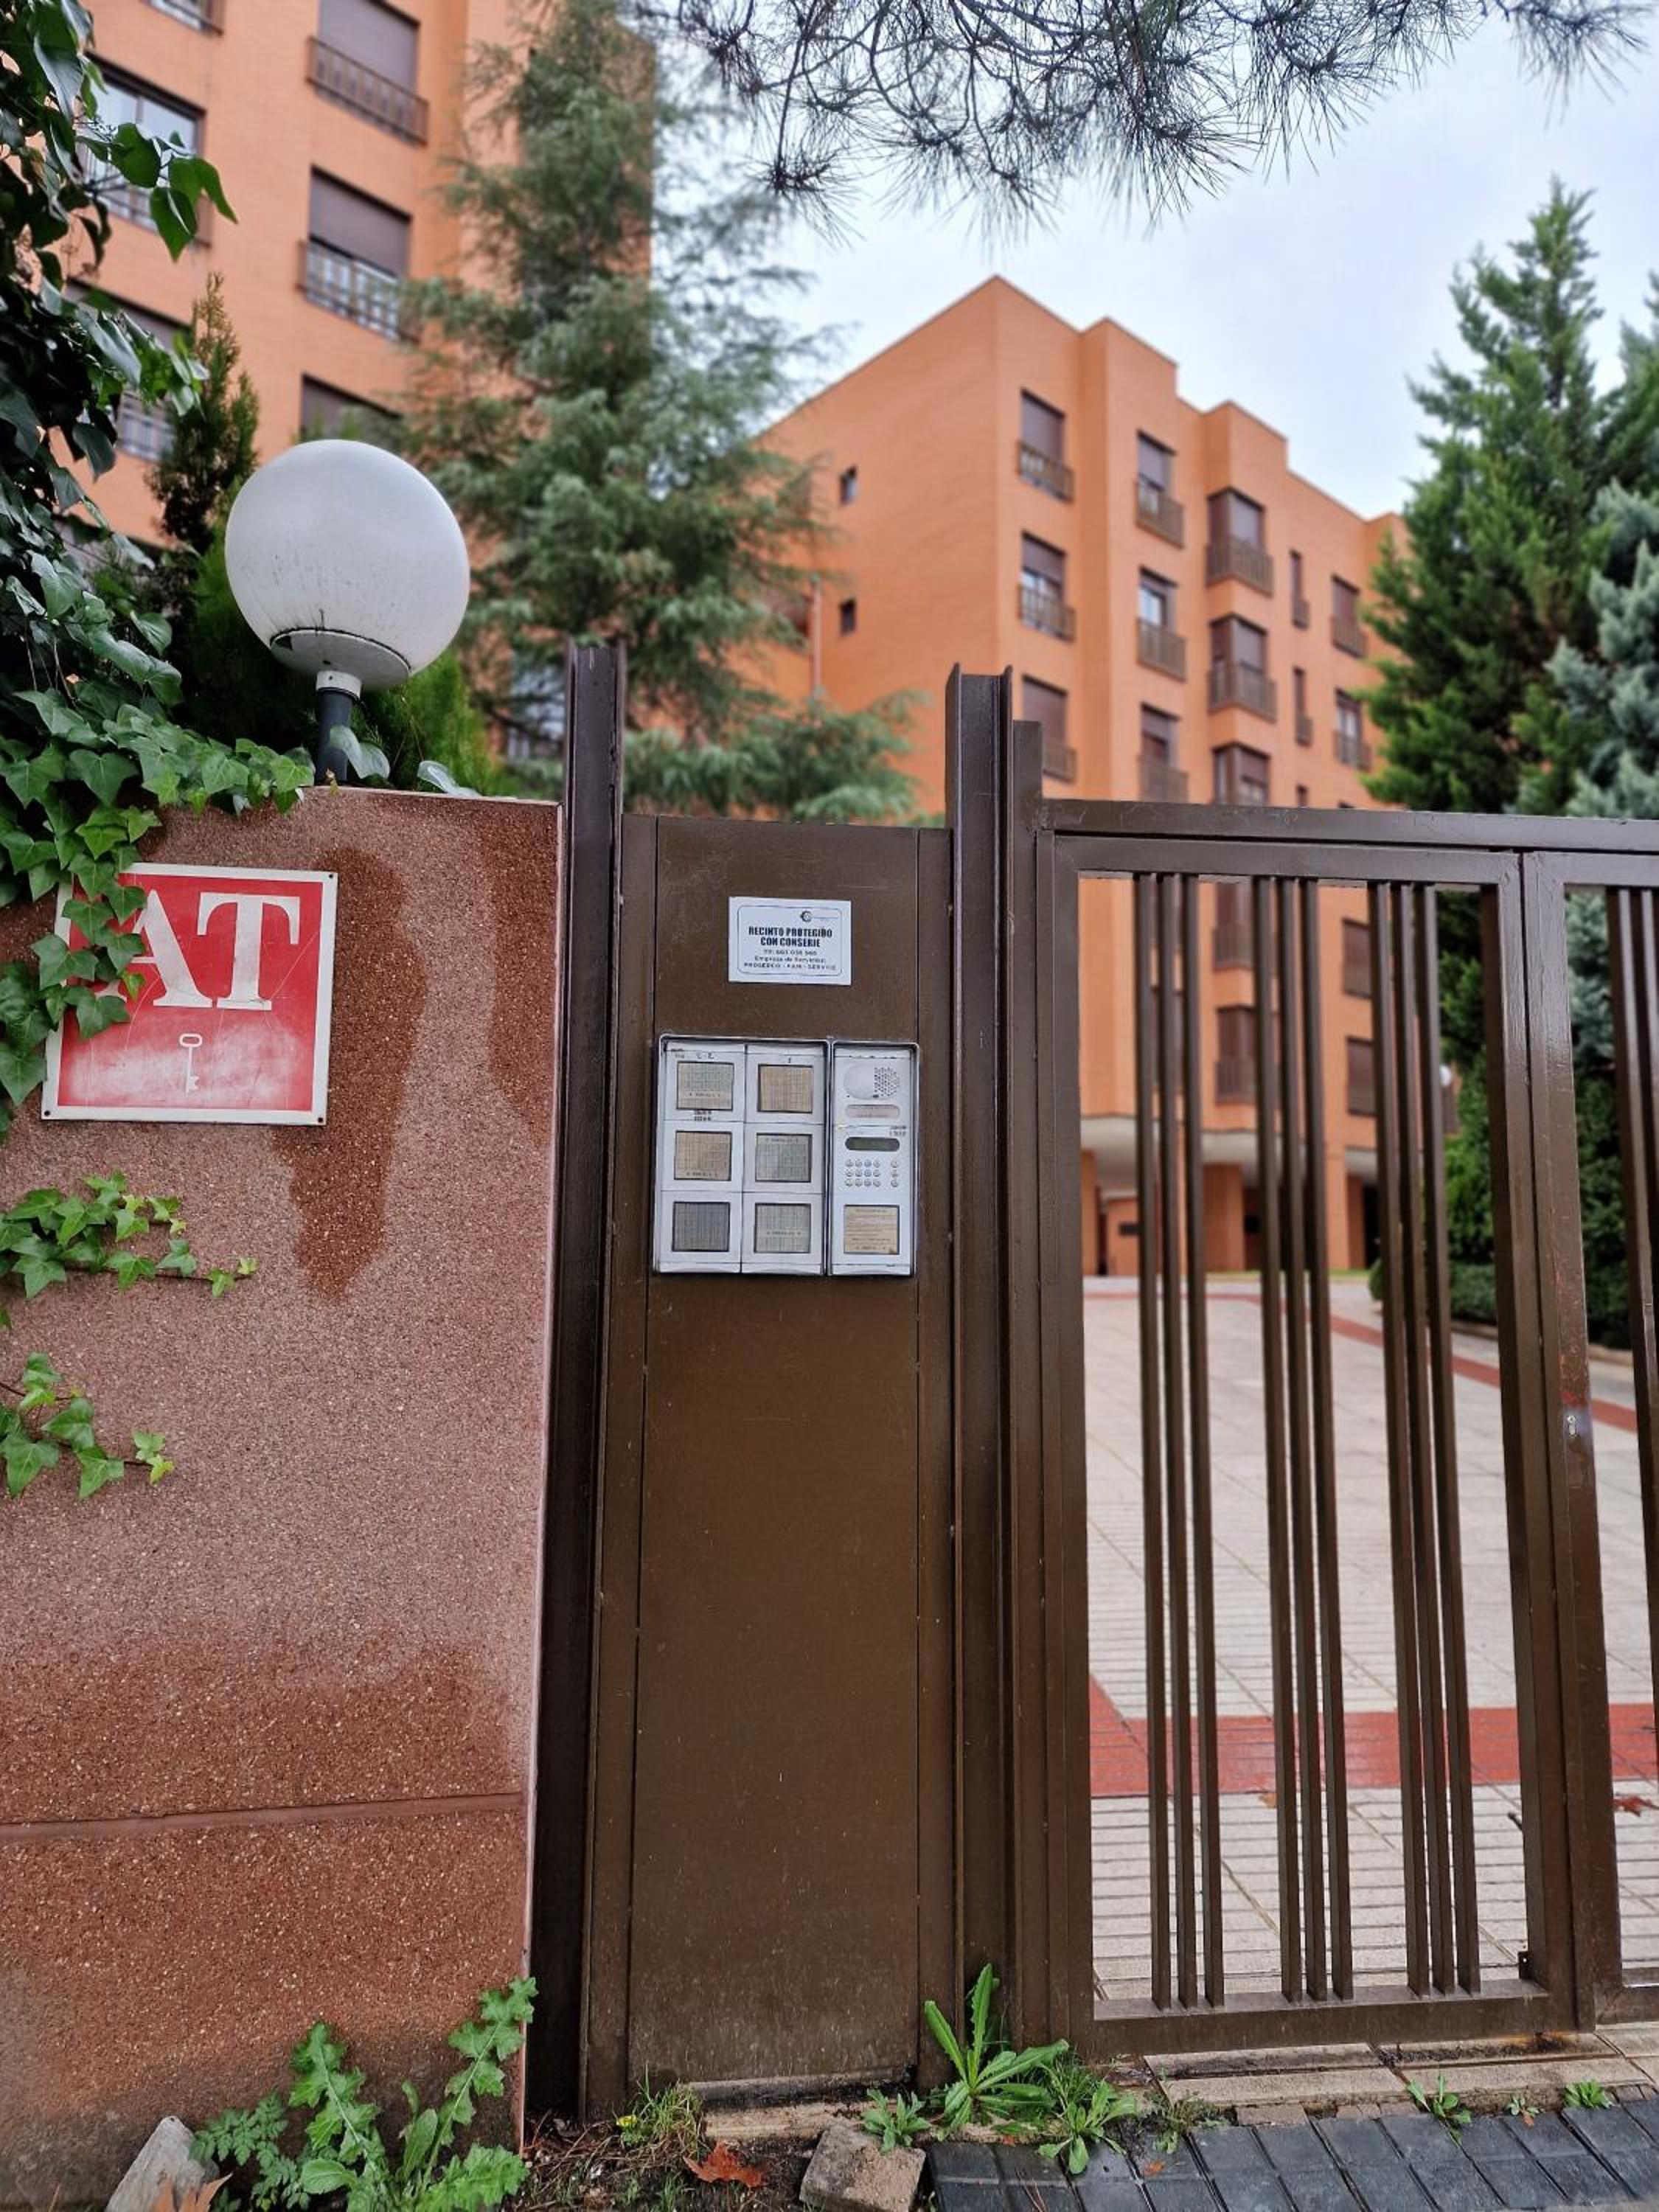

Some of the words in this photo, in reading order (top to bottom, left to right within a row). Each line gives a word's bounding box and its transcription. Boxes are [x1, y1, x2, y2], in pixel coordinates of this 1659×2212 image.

[748, 926, 785, 936] RECINTO
[786, 927, 832, 938] PROTEGIDO
[760, 936, 778, 946] CON
[95, 889, 300, 1010] AT
